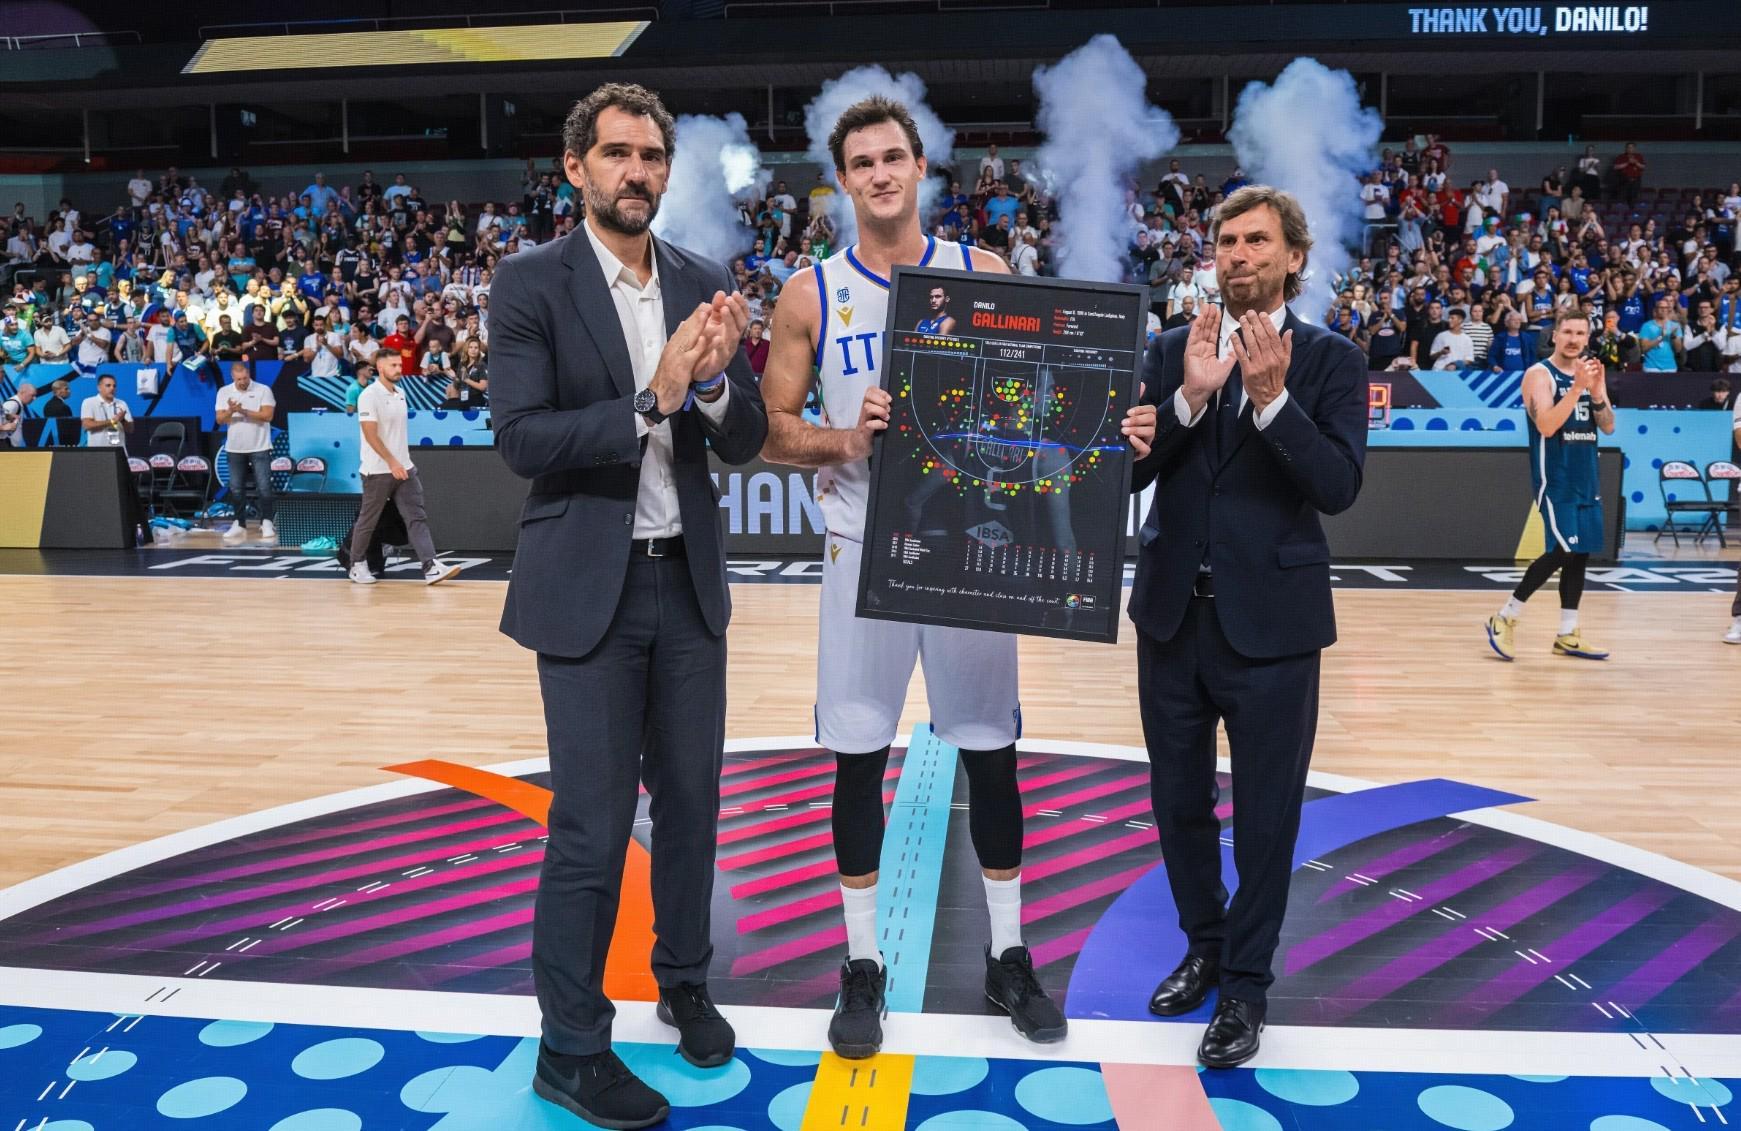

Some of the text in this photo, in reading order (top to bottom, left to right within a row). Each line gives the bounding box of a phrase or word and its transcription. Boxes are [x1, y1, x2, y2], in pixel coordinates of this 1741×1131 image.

[1408, 6, 1648, 36] THANK YOU, DANILO!
[973, 301, 995, 310] DANILO
[972, 312, 1040, 332] GALLINARI
[836, 332, 877, 376] IT
[1000, 348, 1025, 359] 112/241
[1575, 401, 1589, 421] 15
[710, 472, 826, 534] HAN
[976, 526, 1010, 542] IBSA
